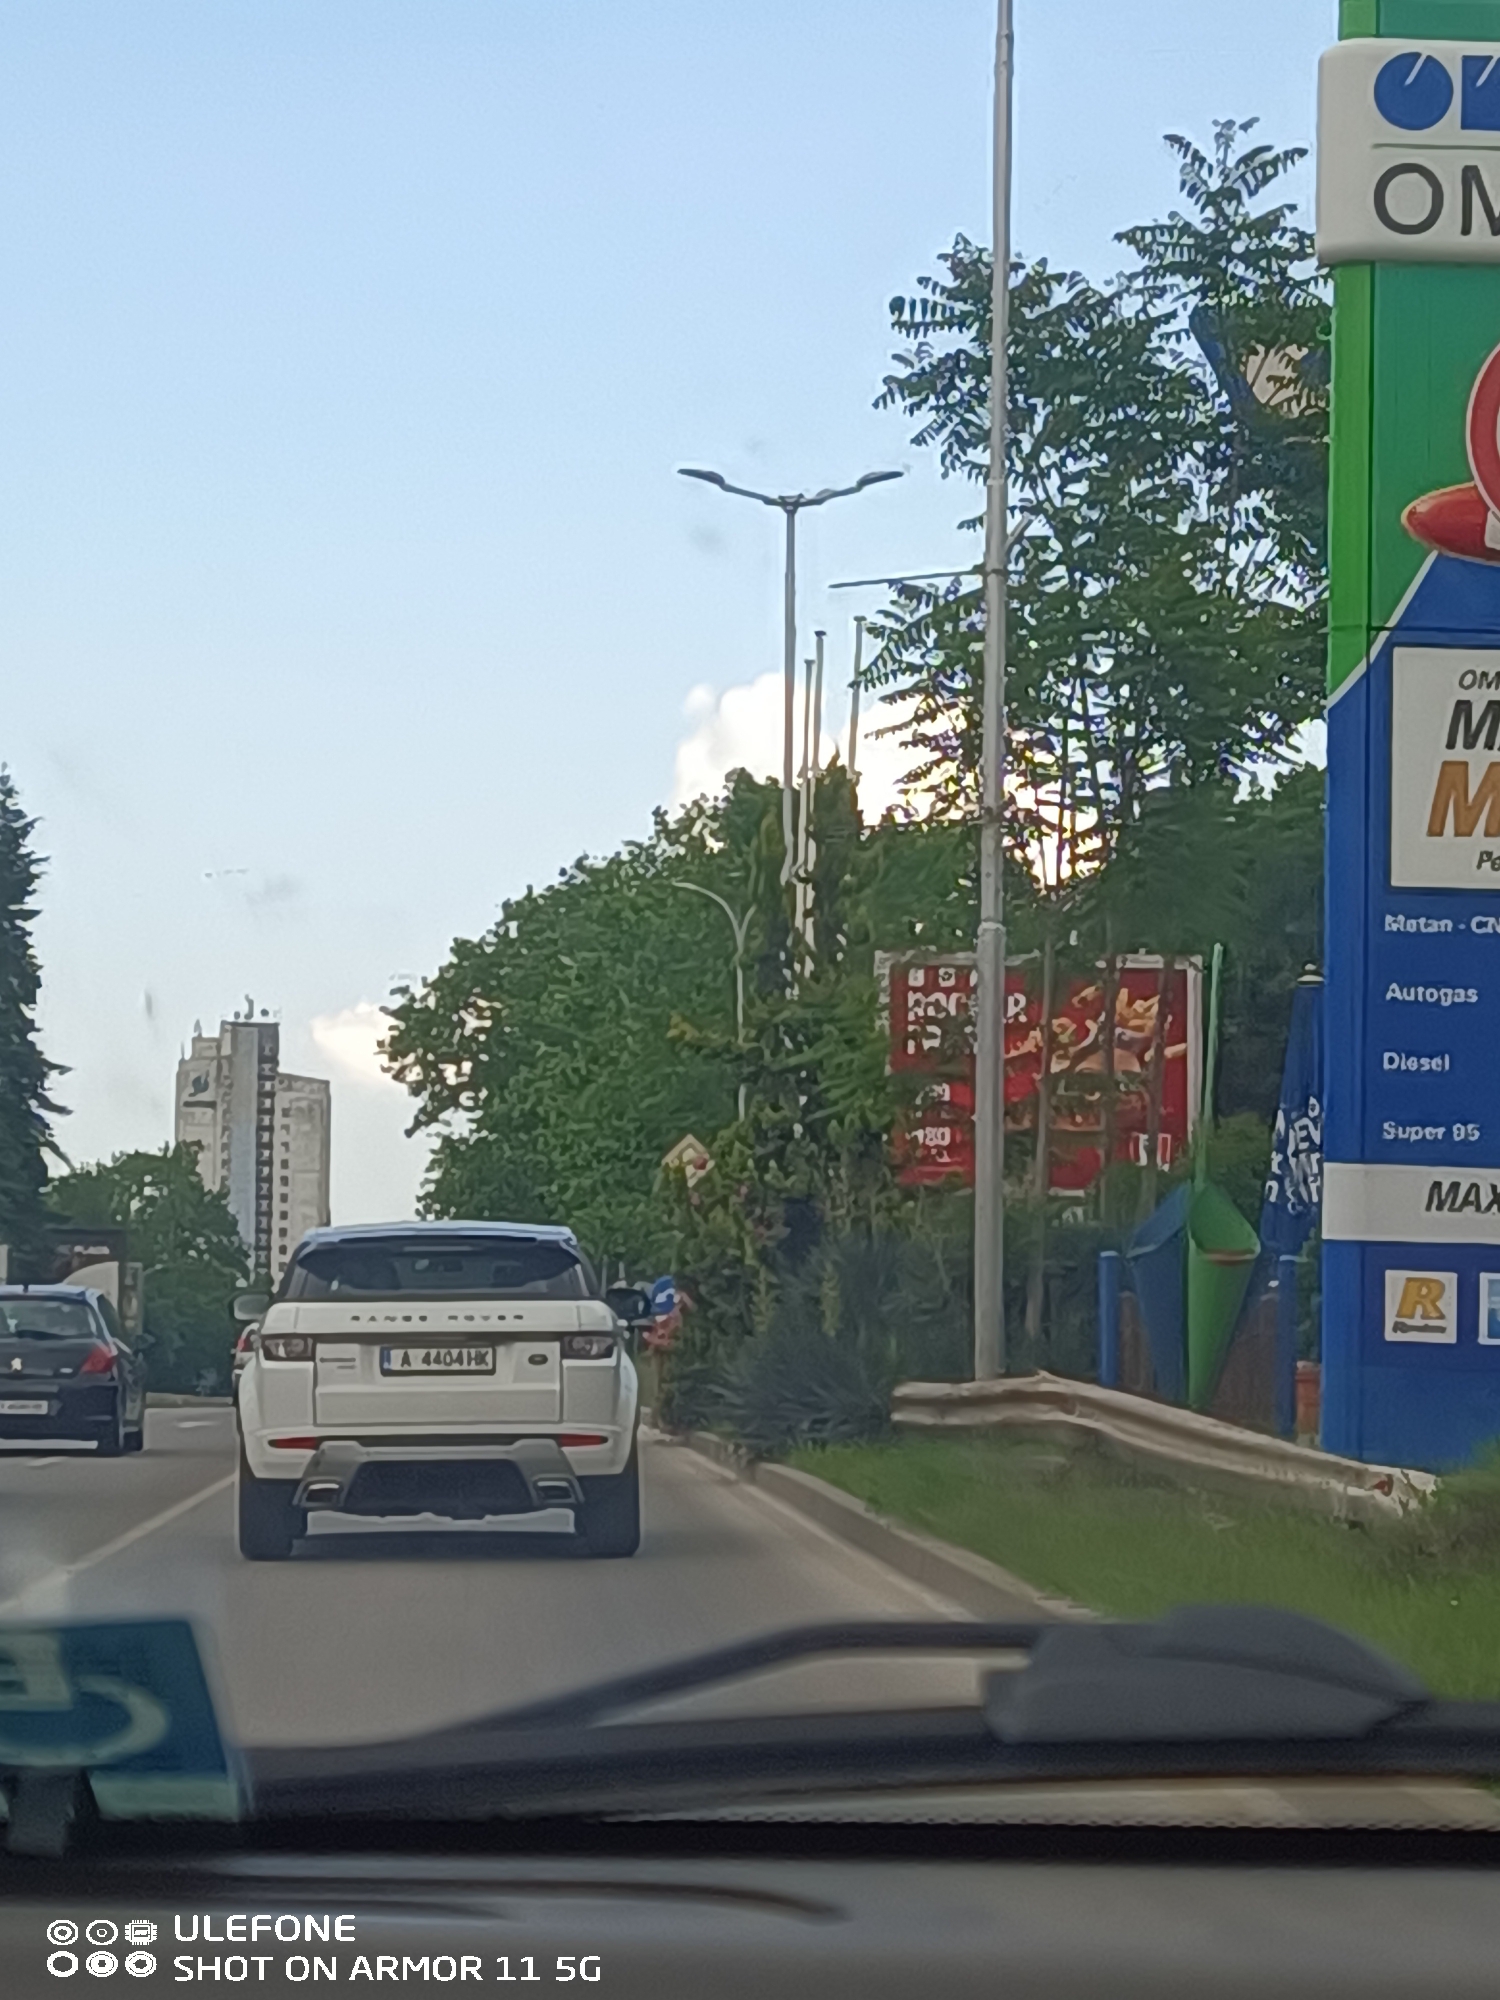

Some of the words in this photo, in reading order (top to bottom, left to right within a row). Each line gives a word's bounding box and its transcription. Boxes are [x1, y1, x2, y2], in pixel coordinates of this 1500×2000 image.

[1385, 982, 1478, 1006] Autogas
[1383, 1052, 1449, 1071] Diesel
[1383, 1121, 1445, 1142] Super
